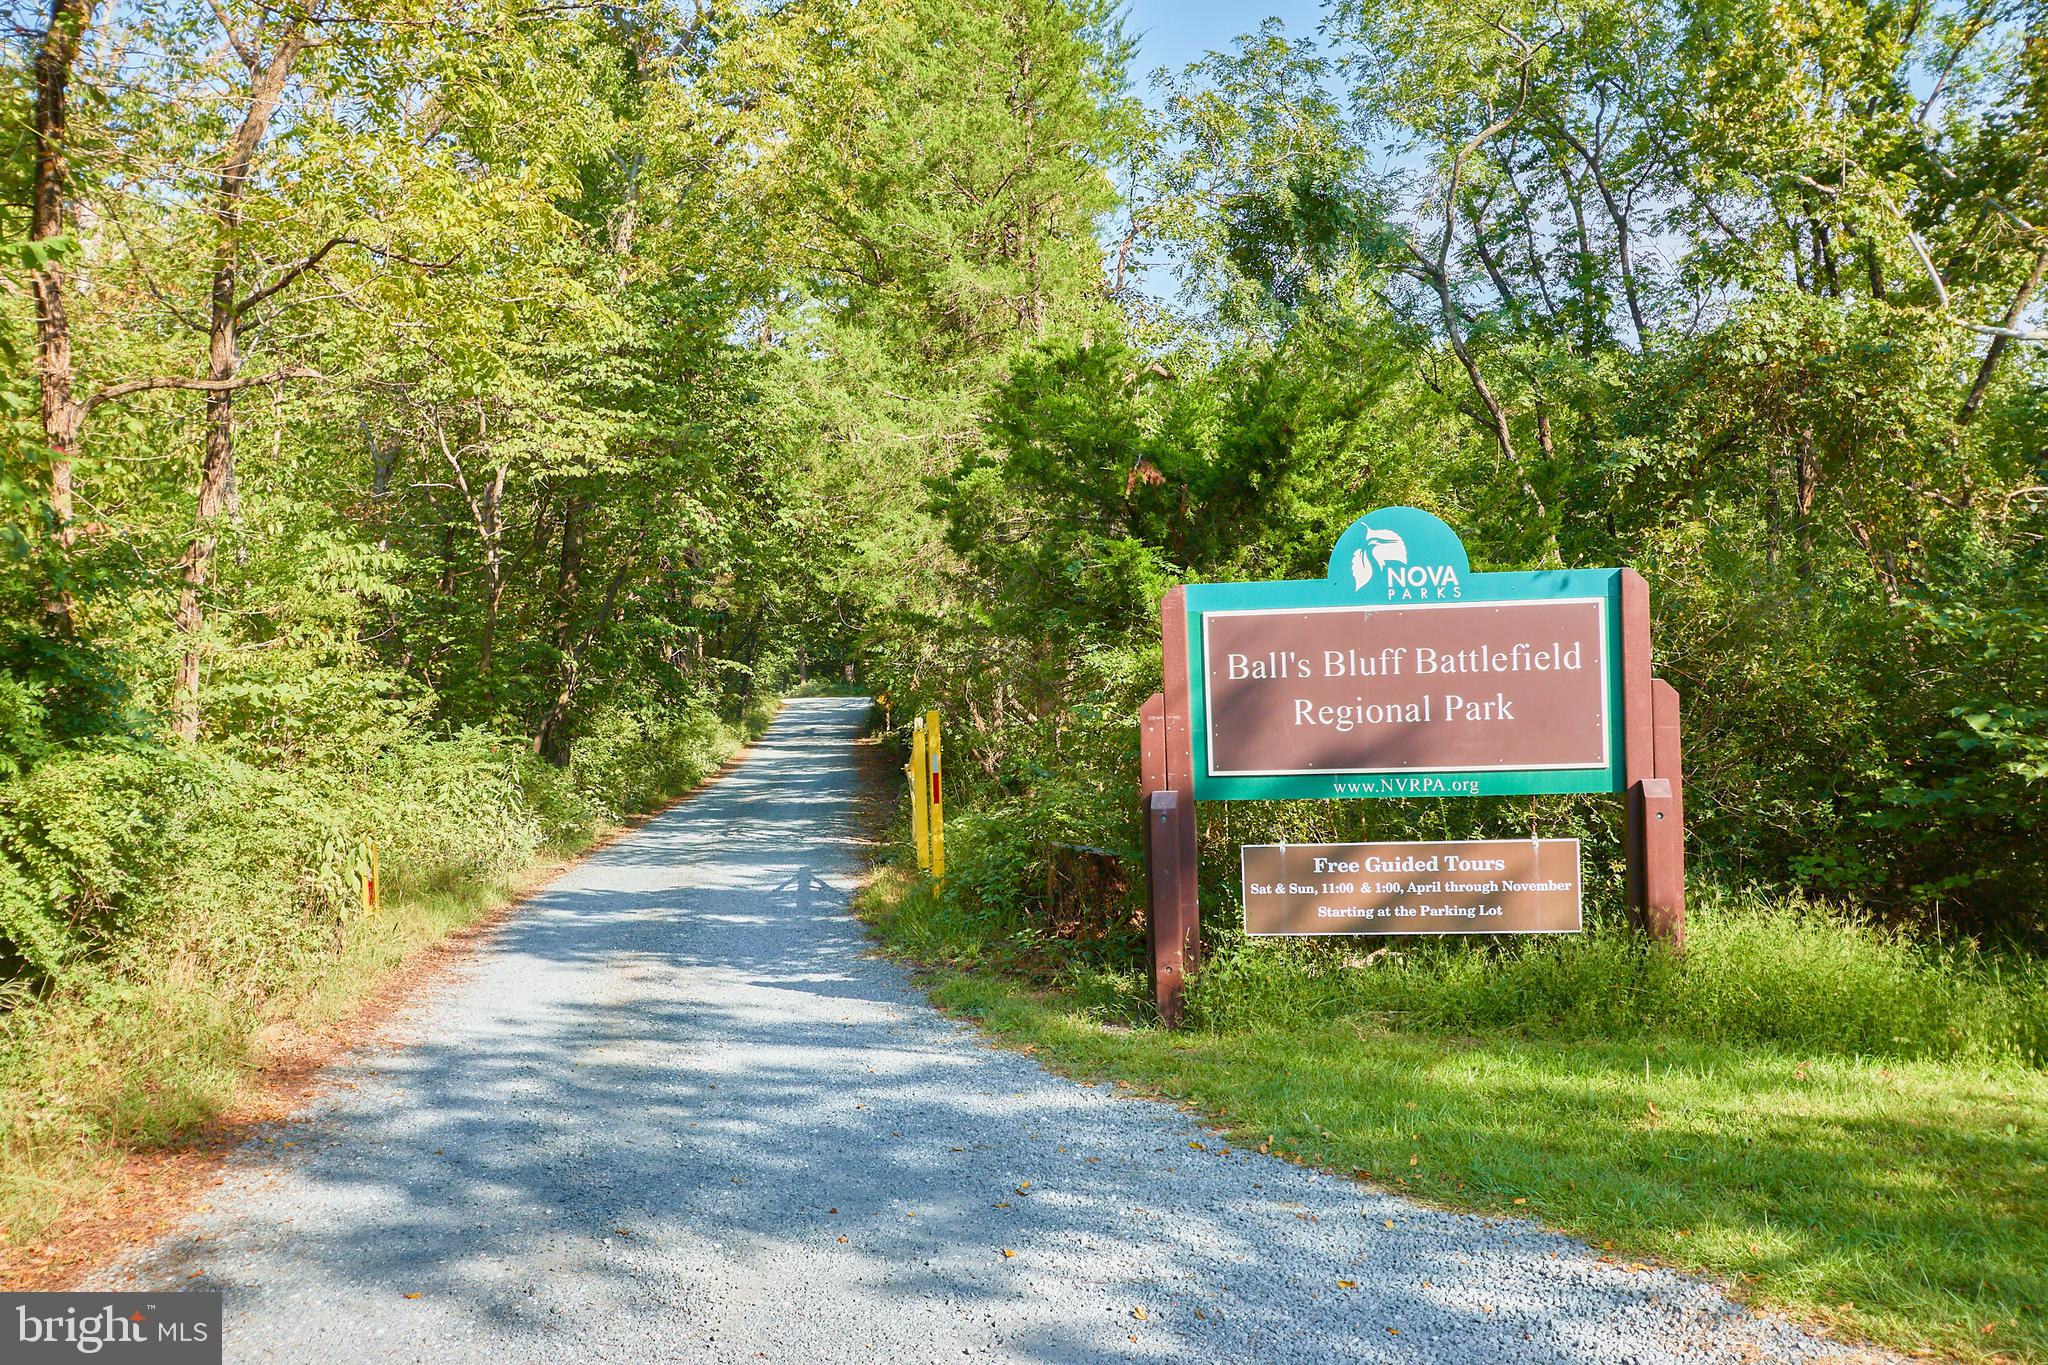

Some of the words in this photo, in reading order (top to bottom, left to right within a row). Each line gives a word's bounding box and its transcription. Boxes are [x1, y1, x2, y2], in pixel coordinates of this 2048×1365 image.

[1387, 565, 1460, 588] NOVA
[1388, 587, 1462, 600] PARKS
[1227, 651, 1312, 680] Ball's
[1323, 647, 1407, 677] Bluff
[1415, 641, 1582, 674] Battlefield
[1294, 694, 1432, 732] Regional
[1444, 692, 1515, 721] Park
[1333, 778, 1479, 794] www.NVRPA.org
[1313, 857, 1360, 873] Free
[1364, 856, 1439, 873] Guided
[1444, 855, 1505, 872] Tours
[1250, 883, 1272, 895] Sat
[1275, 883, 1286, 894] &
[1289, 883, 1319, 896] Sun,
[1321, 882, 1354, 894] 11:00
[1360, 882, 1372, 894] &
[1375, 882, 1404, 895] 1:00,
[1406, 881, 1441, 895] April
[1444, 880, 1499, 895] through
[1501, 880, 1572, 892] November
[1318, 906, 1374, 919] Starting
[1377, 906, 1391, 917] at
[1394, 906, 1417, 917] the
[1419, 905, 1476, 918] Parking
[1479, 904, 1503, 916] Lot
